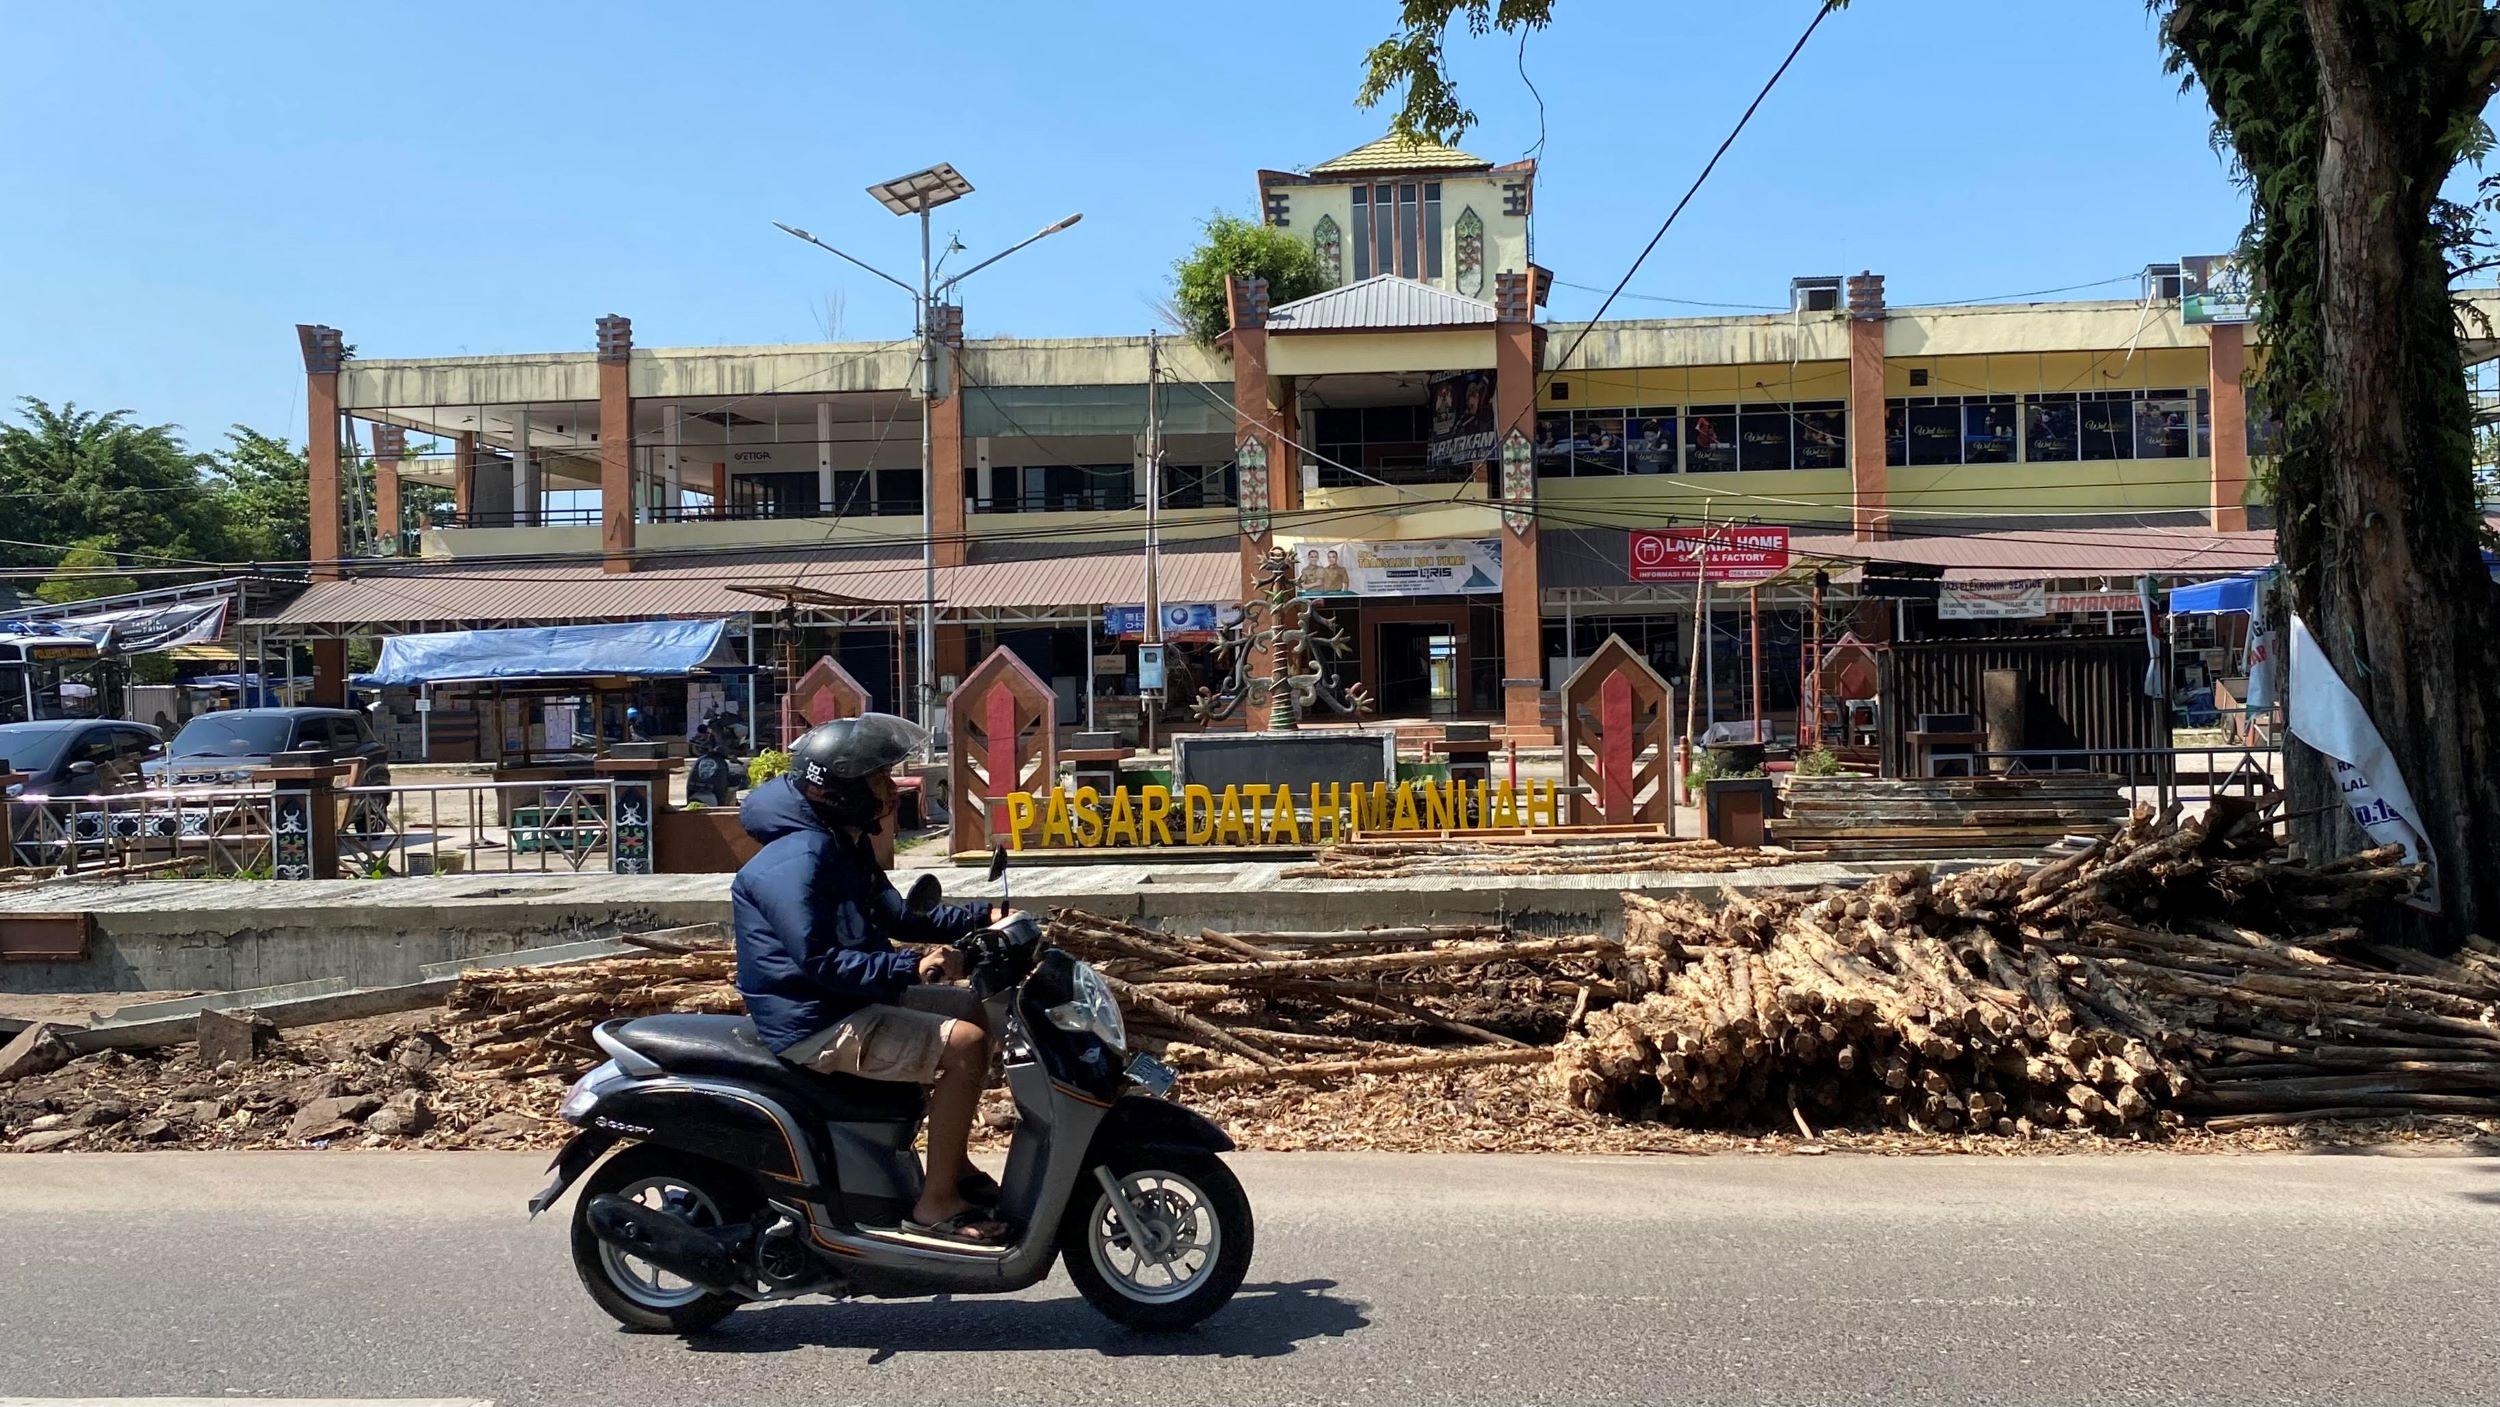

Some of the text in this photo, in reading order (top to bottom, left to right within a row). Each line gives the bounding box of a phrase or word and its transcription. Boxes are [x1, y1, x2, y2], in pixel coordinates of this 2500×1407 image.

[1737, 535, 1783, 552] HOME
[1712, 554, 1719, 562] &
[1722, 553, 1766, 562] FACTORY
[1007, 784, 1173, 852] PASAR
[1350, 778, 1555, 838] MANUAH
